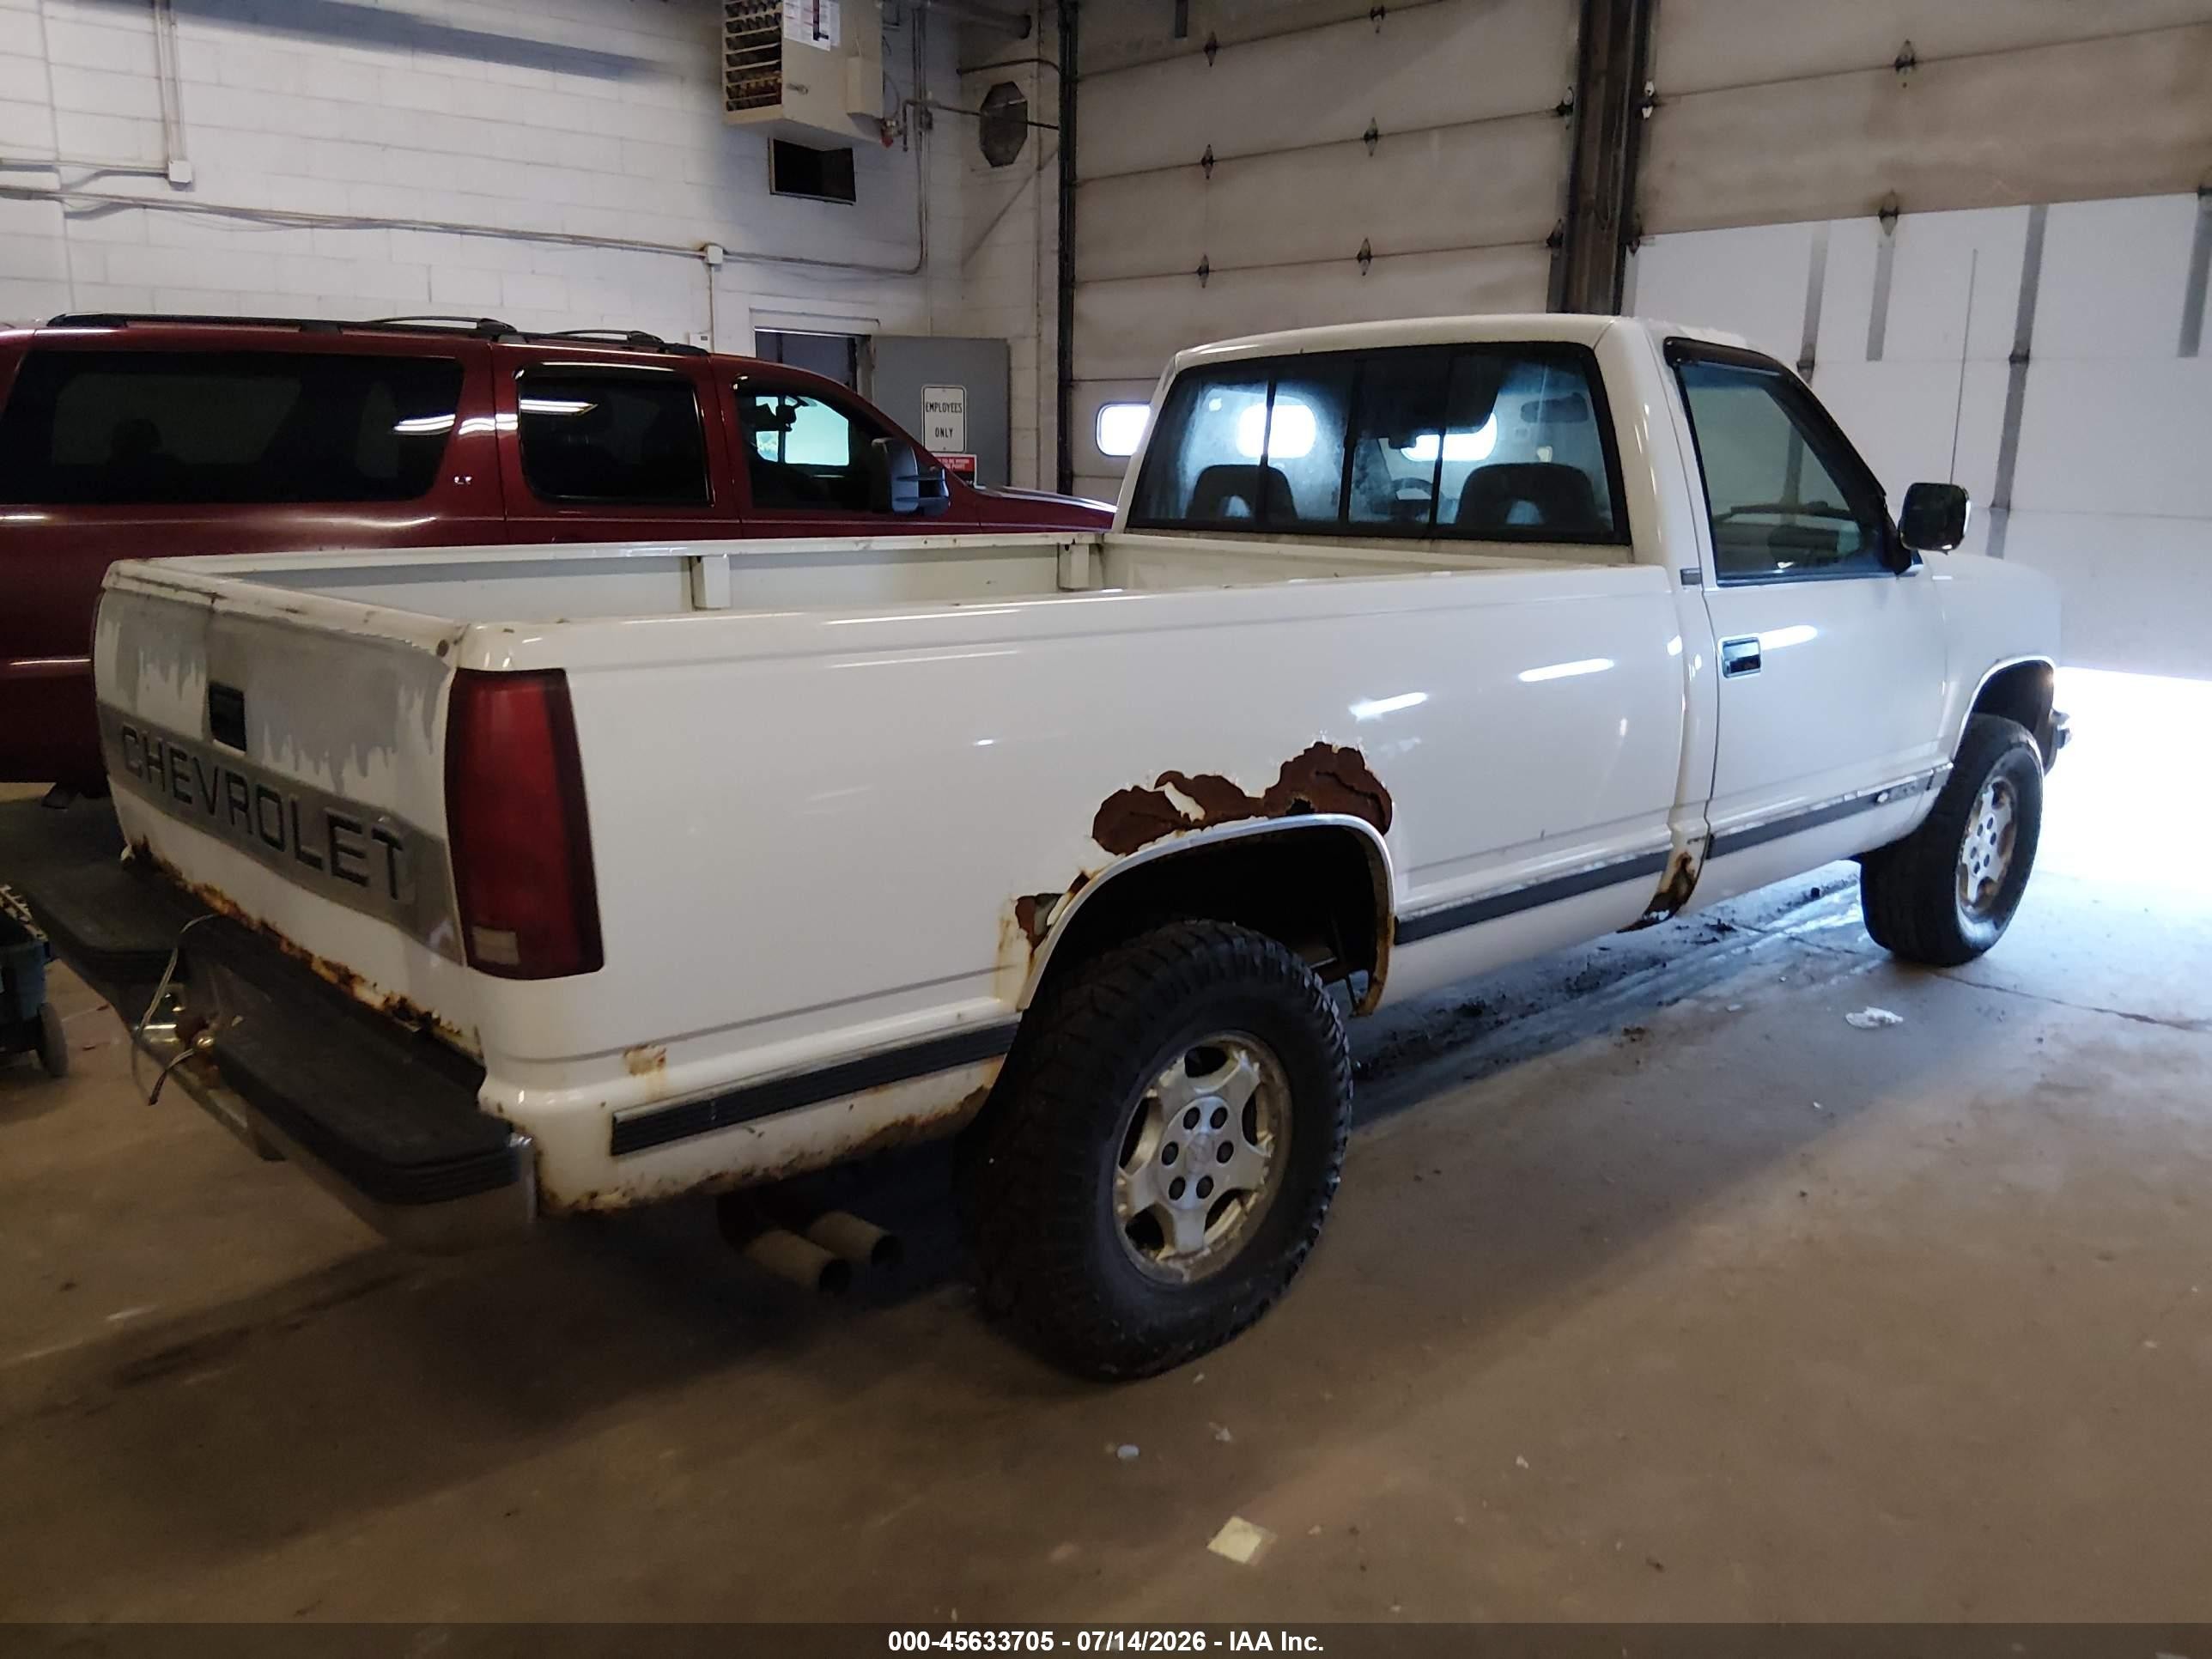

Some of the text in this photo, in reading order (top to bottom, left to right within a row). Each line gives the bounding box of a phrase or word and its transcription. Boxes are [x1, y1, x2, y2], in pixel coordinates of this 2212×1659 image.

[925, 402, 963, 414] EMPLOYEES
[934, 427, 954, 439] ONLY
[121, 726, 407, 901] CHEVROLET
